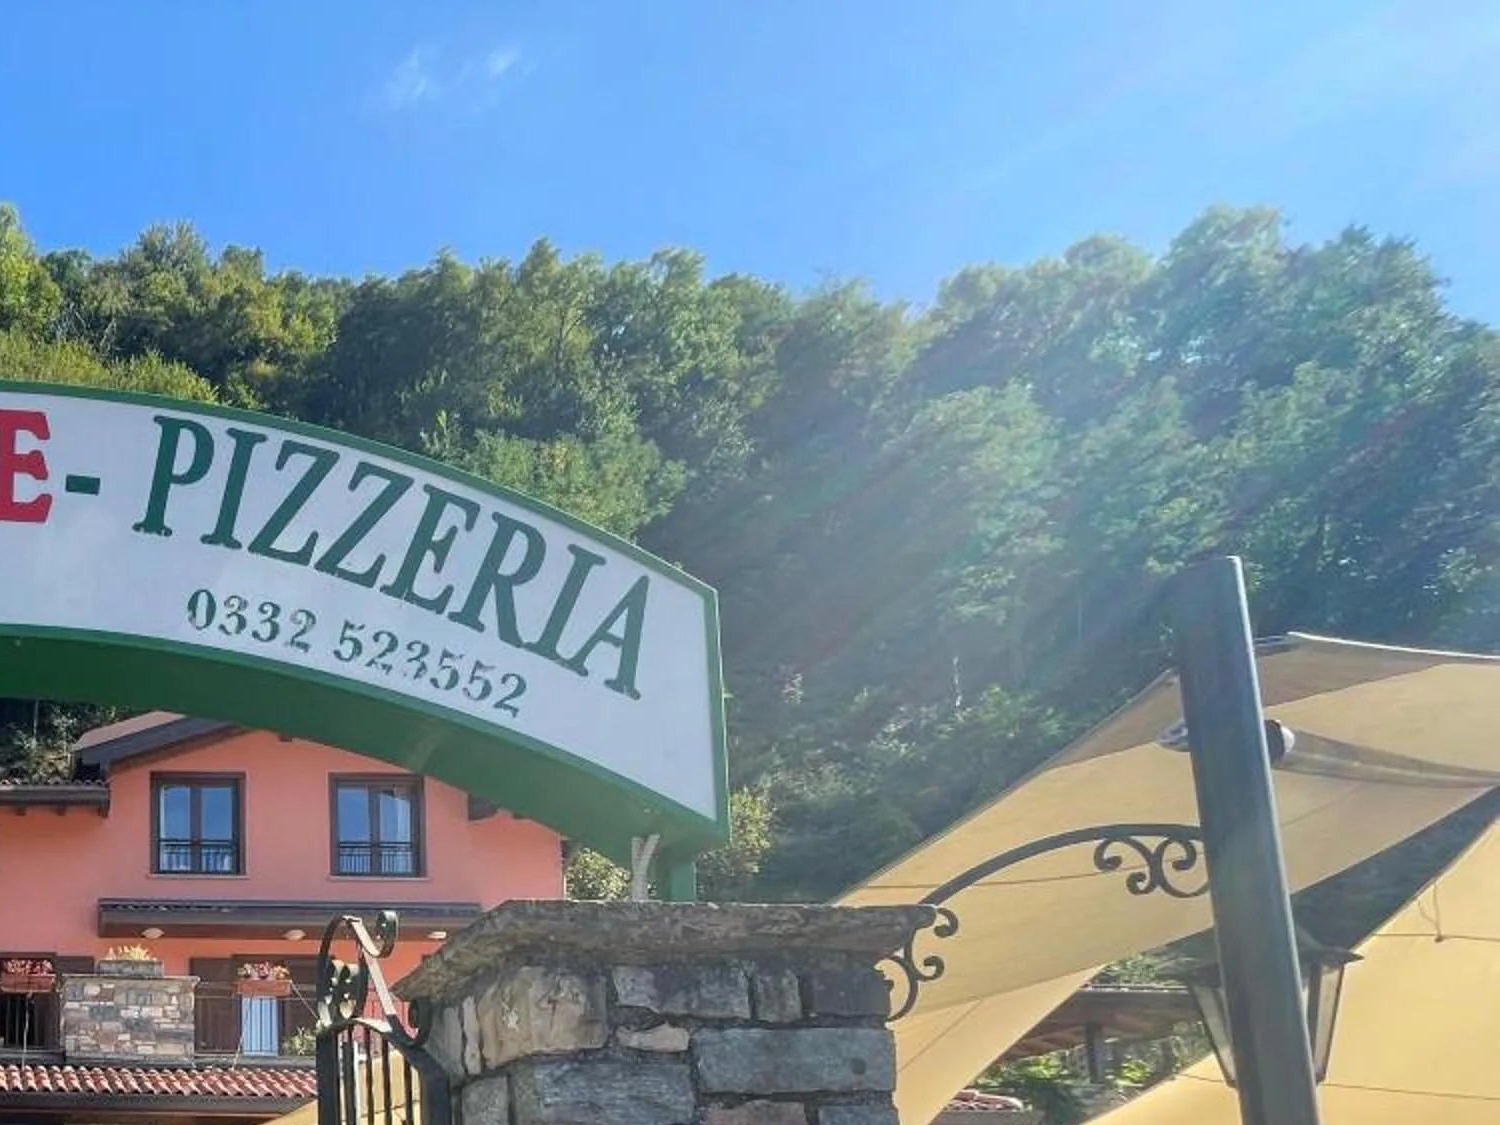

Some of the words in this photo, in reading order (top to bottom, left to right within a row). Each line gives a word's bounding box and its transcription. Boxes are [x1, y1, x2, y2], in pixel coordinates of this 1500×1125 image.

[132, 414, 652, 702] PIZZERIA
[187, 588, 318, 654] 0332
[332, 619, 528, 719] 523552
